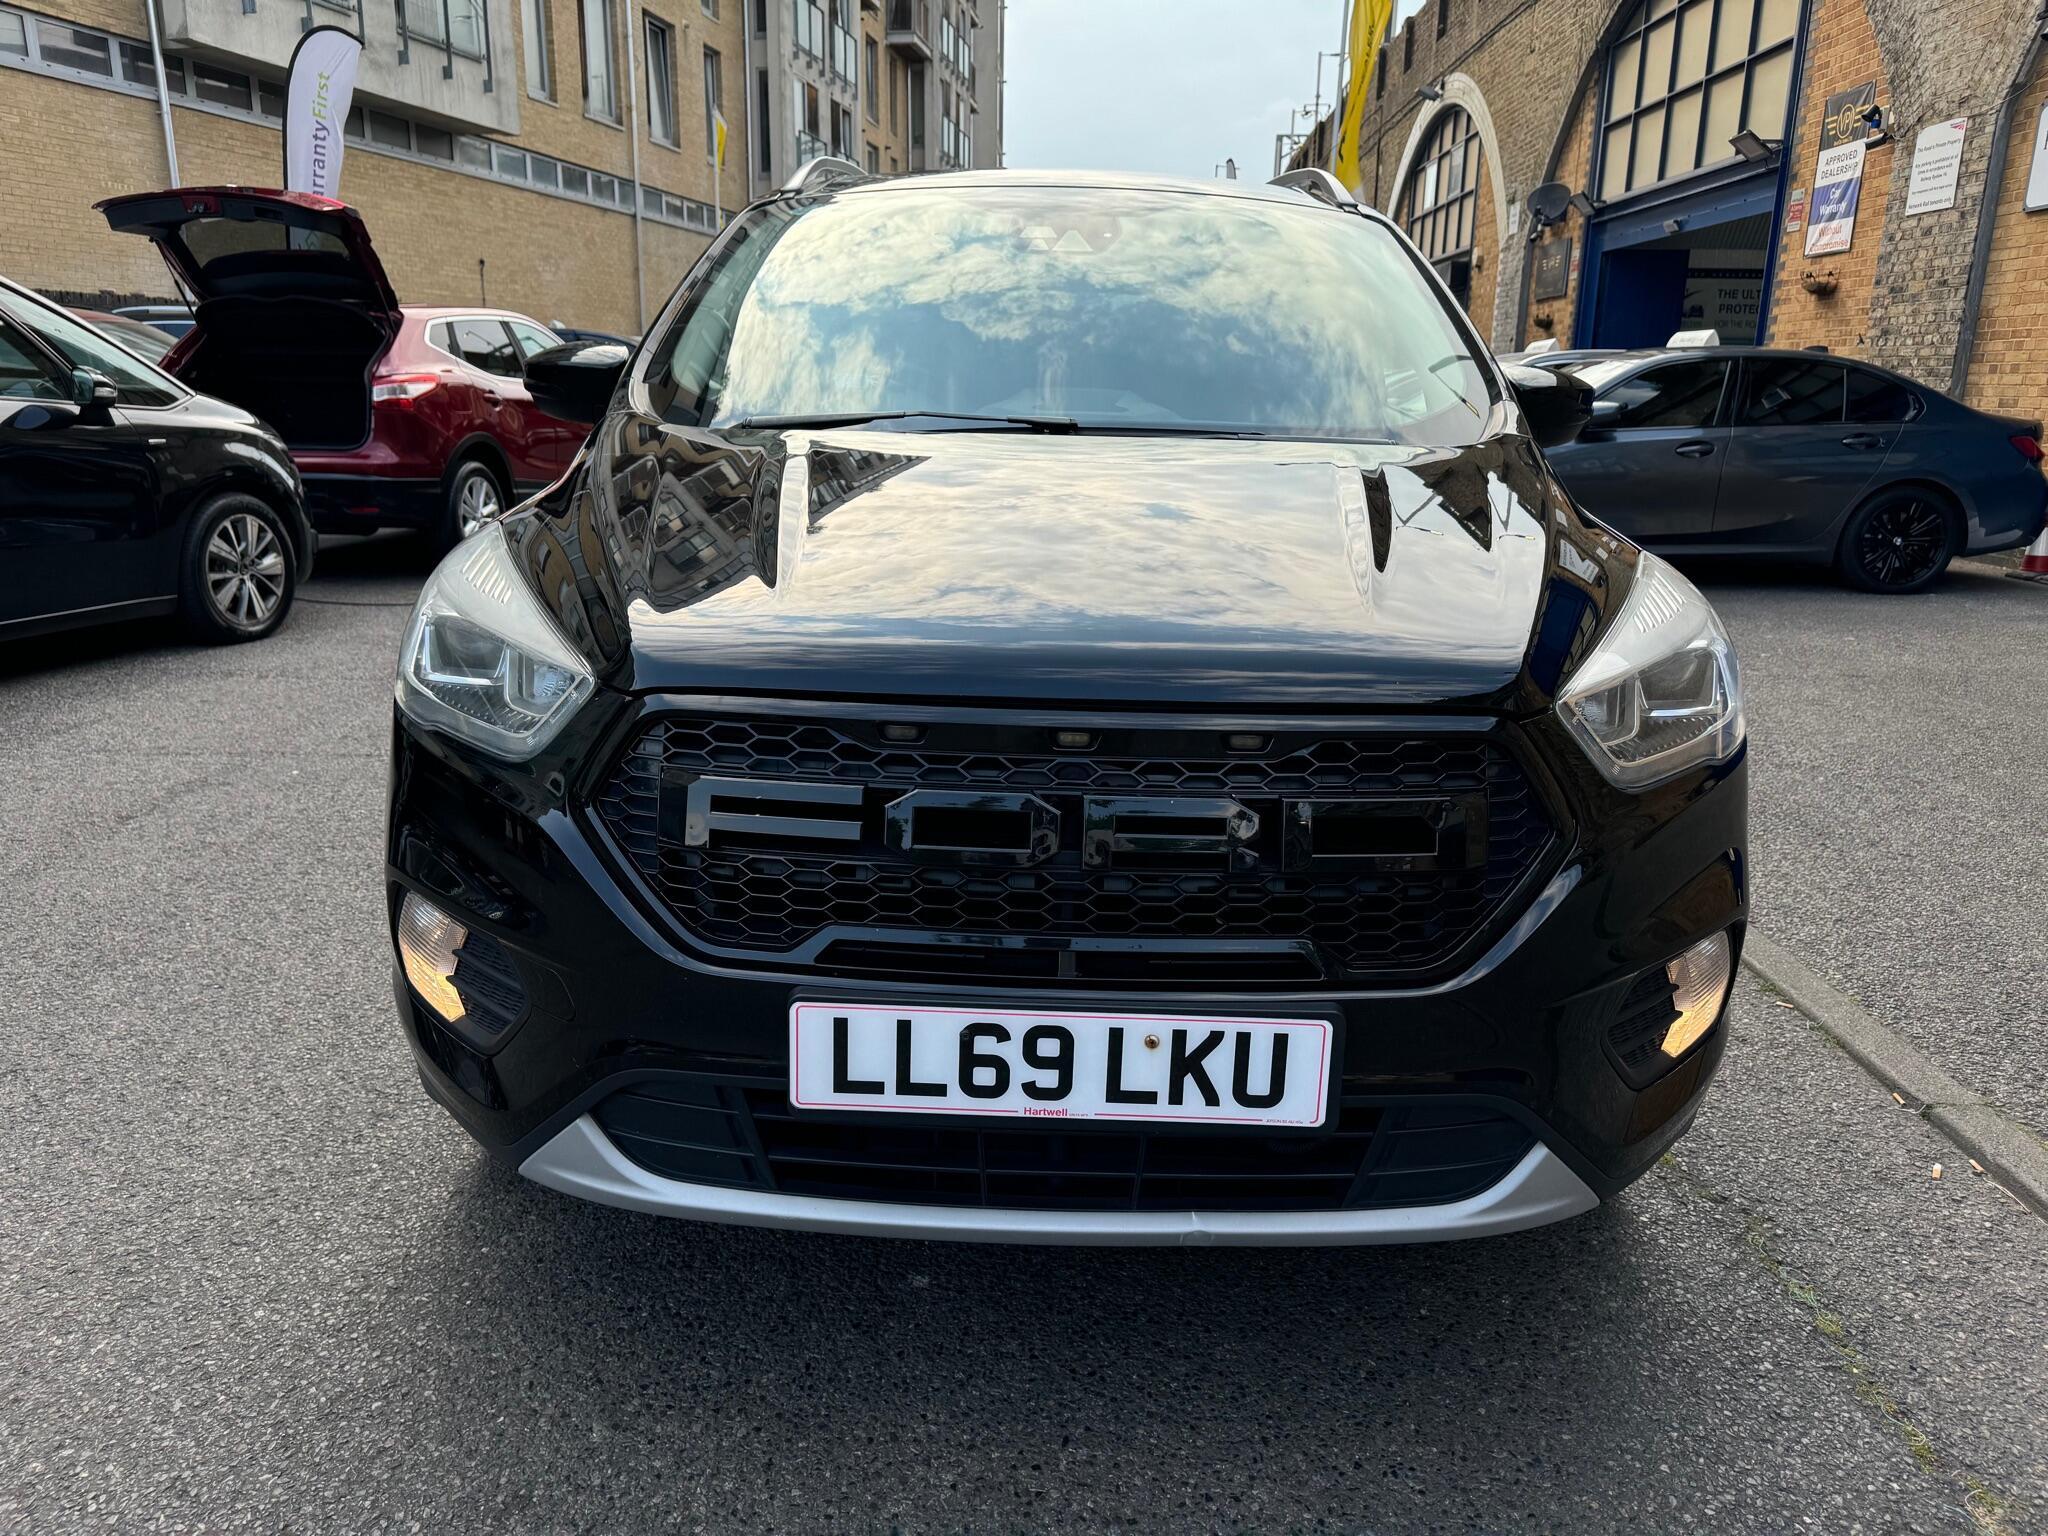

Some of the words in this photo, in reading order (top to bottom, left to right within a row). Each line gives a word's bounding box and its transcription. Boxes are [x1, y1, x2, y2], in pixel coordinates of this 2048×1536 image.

[1825, 150, 1858, 167] APPROVED
[1821, 161, 1859, 180] DEALERSHIP
[1718, 289, 1739, 299] THE
[676, 773, 1477, 874] FORD
[833, 1017, 1075, 1101] LL69
[1105, 1027, 1289, 1109] LKU
[1024, 1107, 1068, 1117] Hartwell
